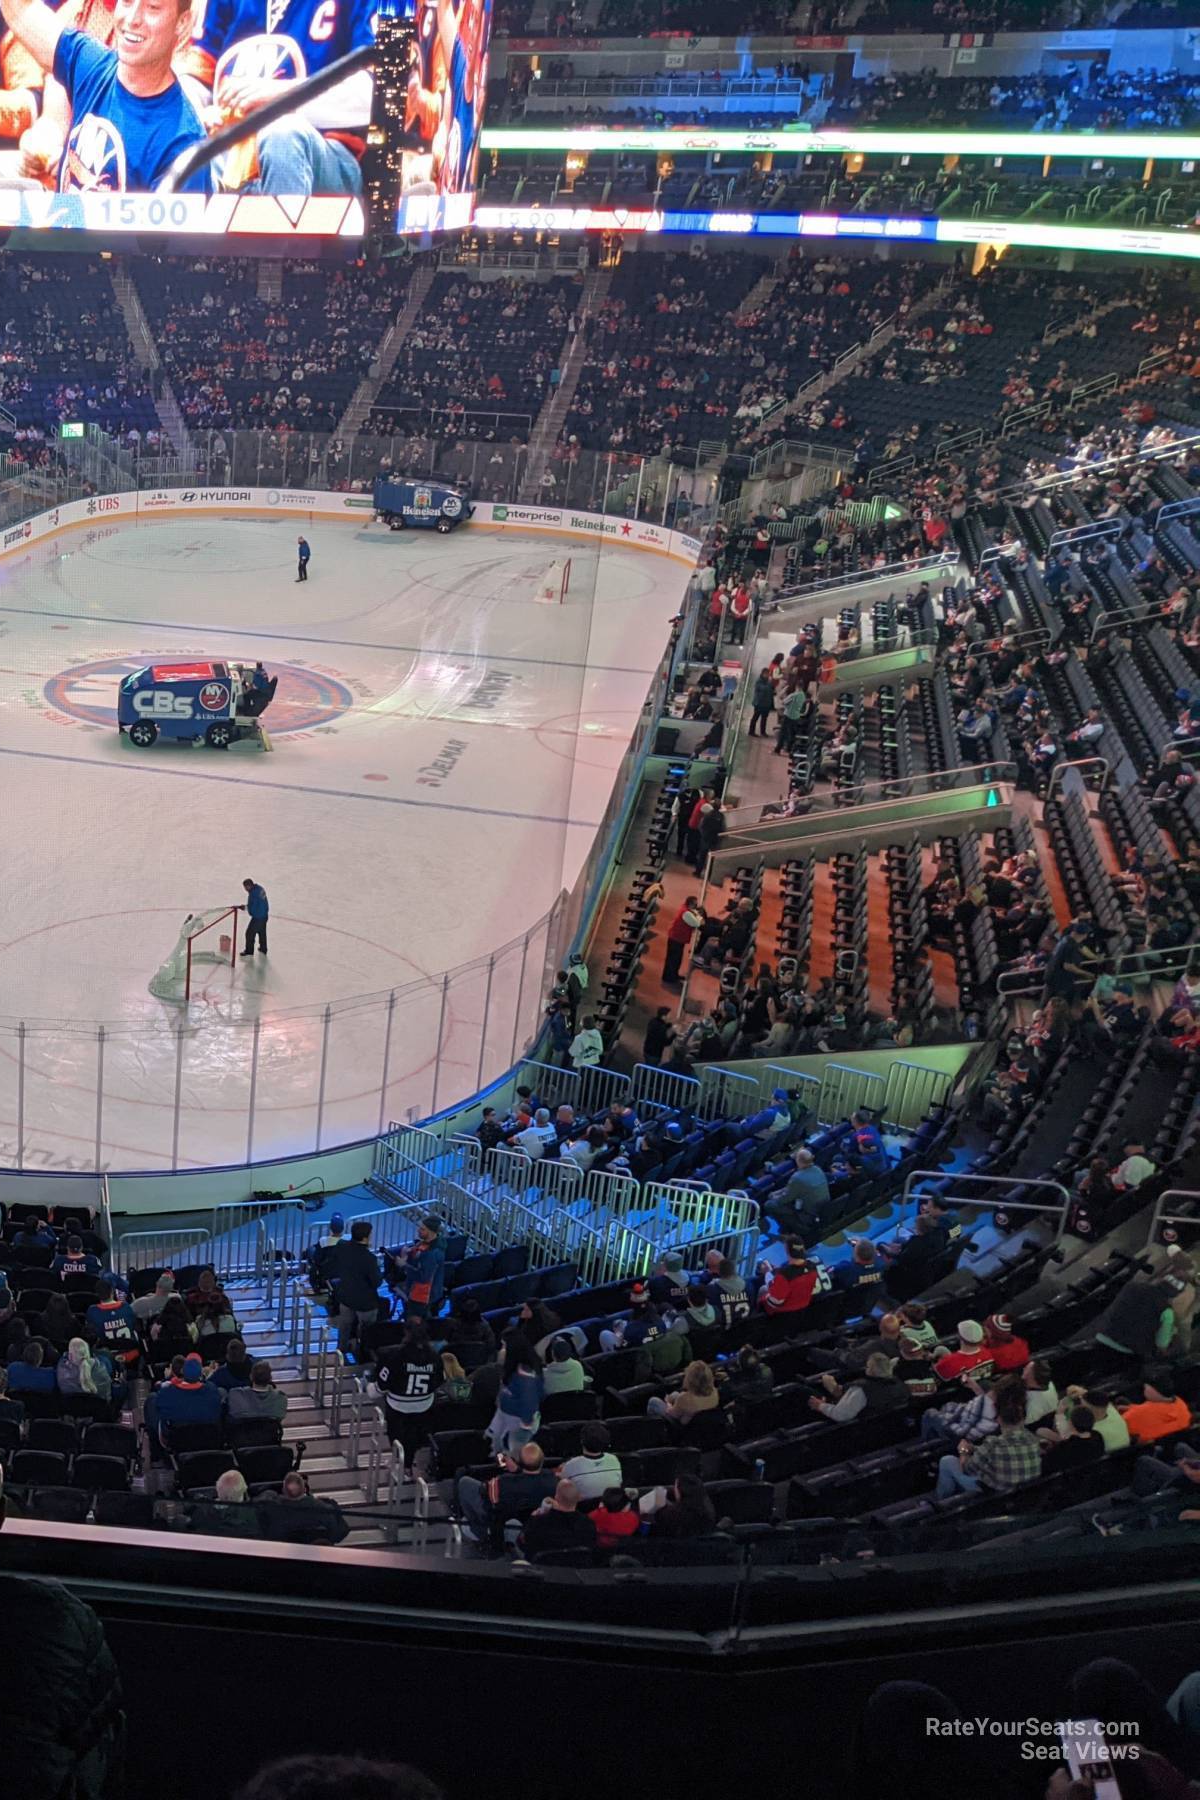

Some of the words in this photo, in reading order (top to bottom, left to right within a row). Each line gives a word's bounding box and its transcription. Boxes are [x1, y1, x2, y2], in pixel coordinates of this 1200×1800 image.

[201, 492, 251, 501] HYUNDAI
[98, 496, 120, 511] UBS
[570, 517, 617, 534] Heineken
[719, 1291, 749, 1303] BARZAL
[103, 1318, 127, 1330] BARZAL
[405, 1374, 431, 1396] 15
